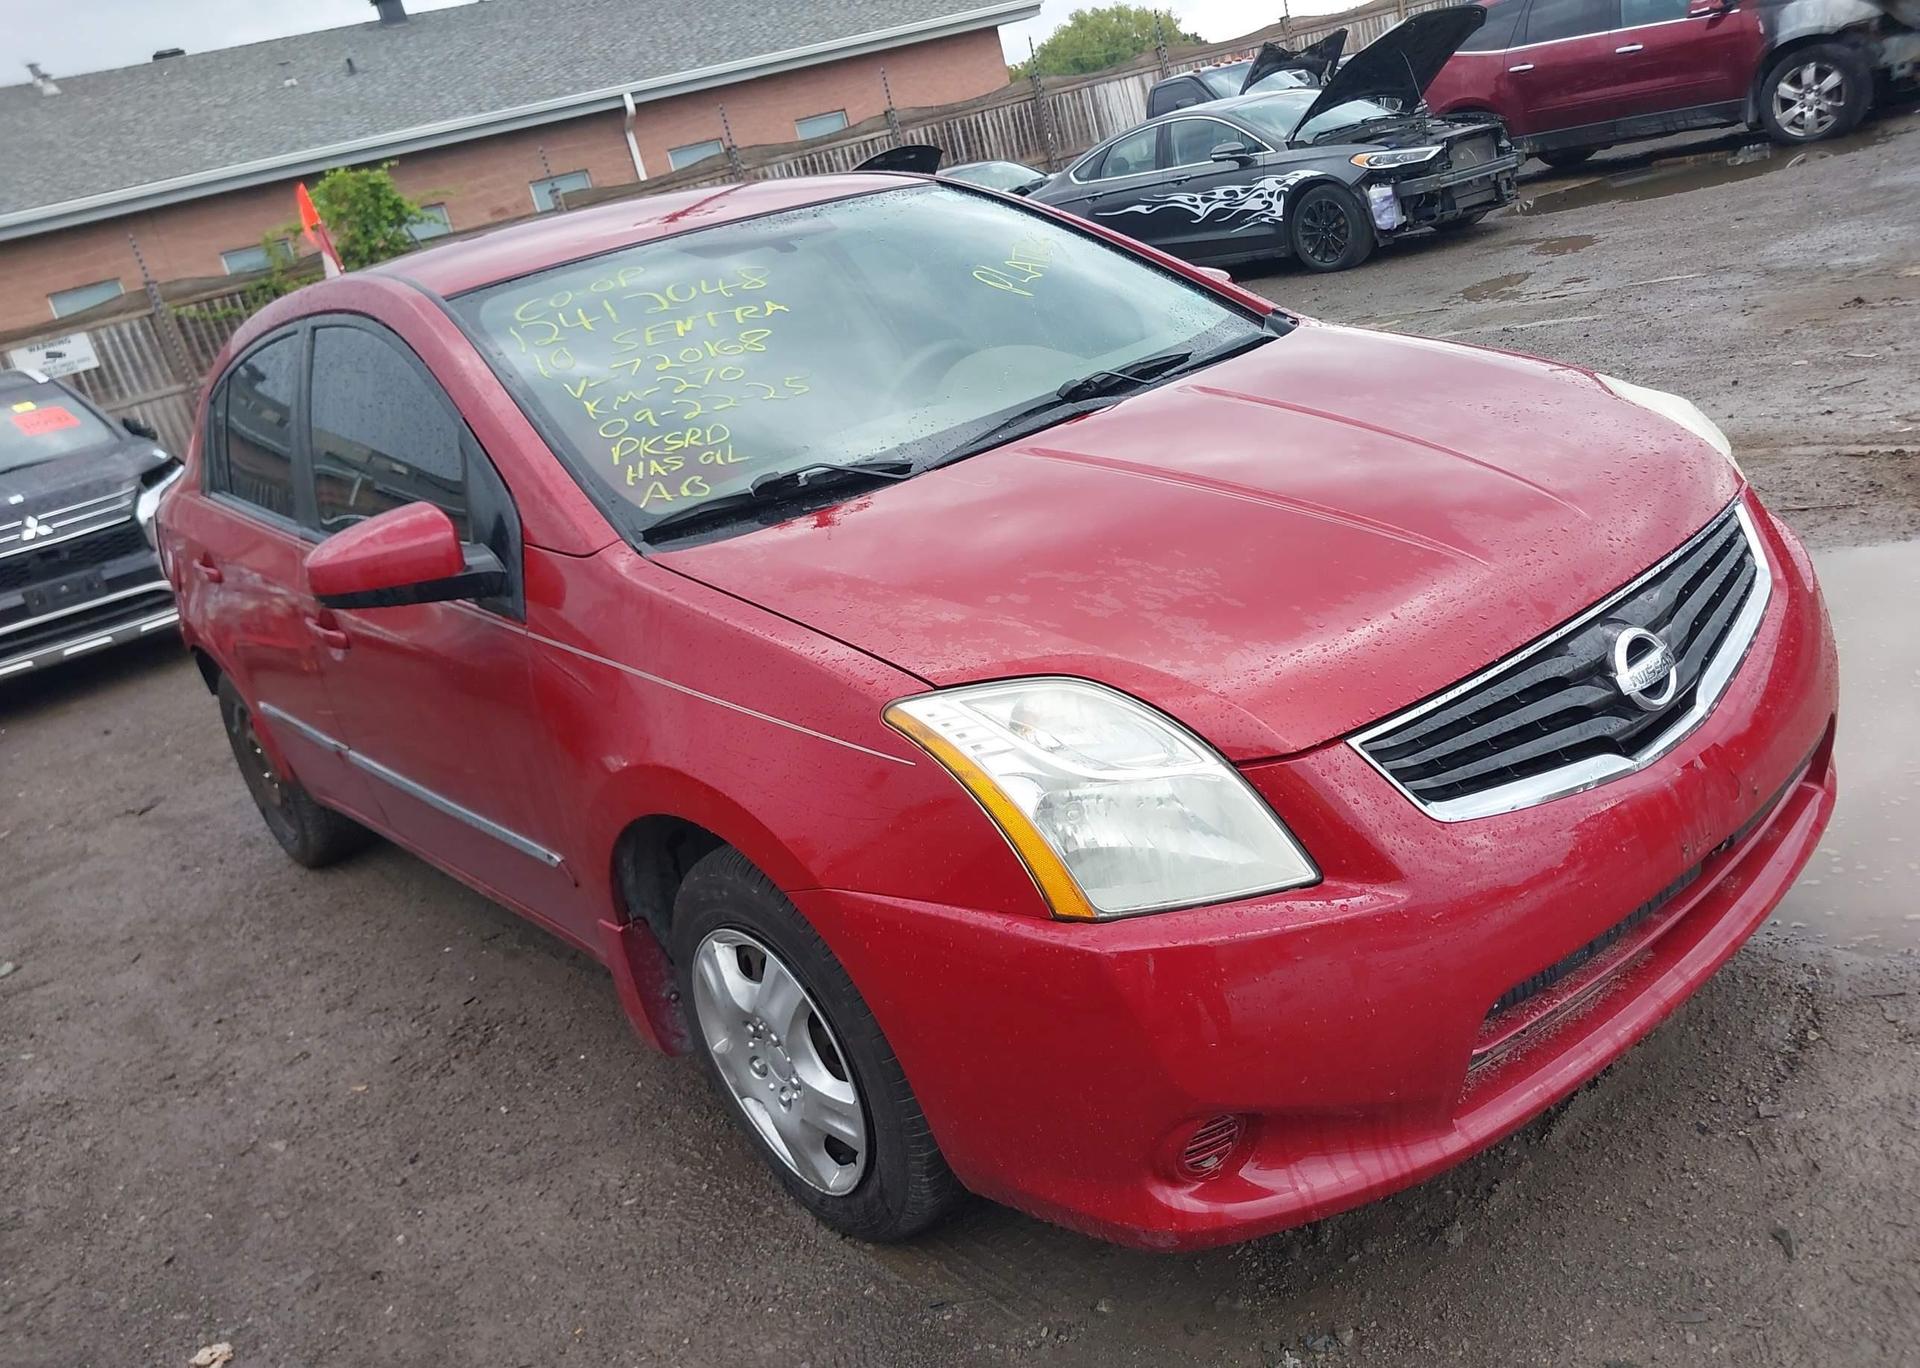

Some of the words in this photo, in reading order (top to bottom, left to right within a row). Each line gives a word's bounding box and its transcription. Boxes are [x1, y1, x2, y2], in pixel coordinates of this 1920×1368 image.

[514, 266, 645, 323] CO-OP
[611, 301, 790, 354] SENTRA
[626, 456, 685, 486] HAS
[1630, 652, 1672, 688] NISSAN
